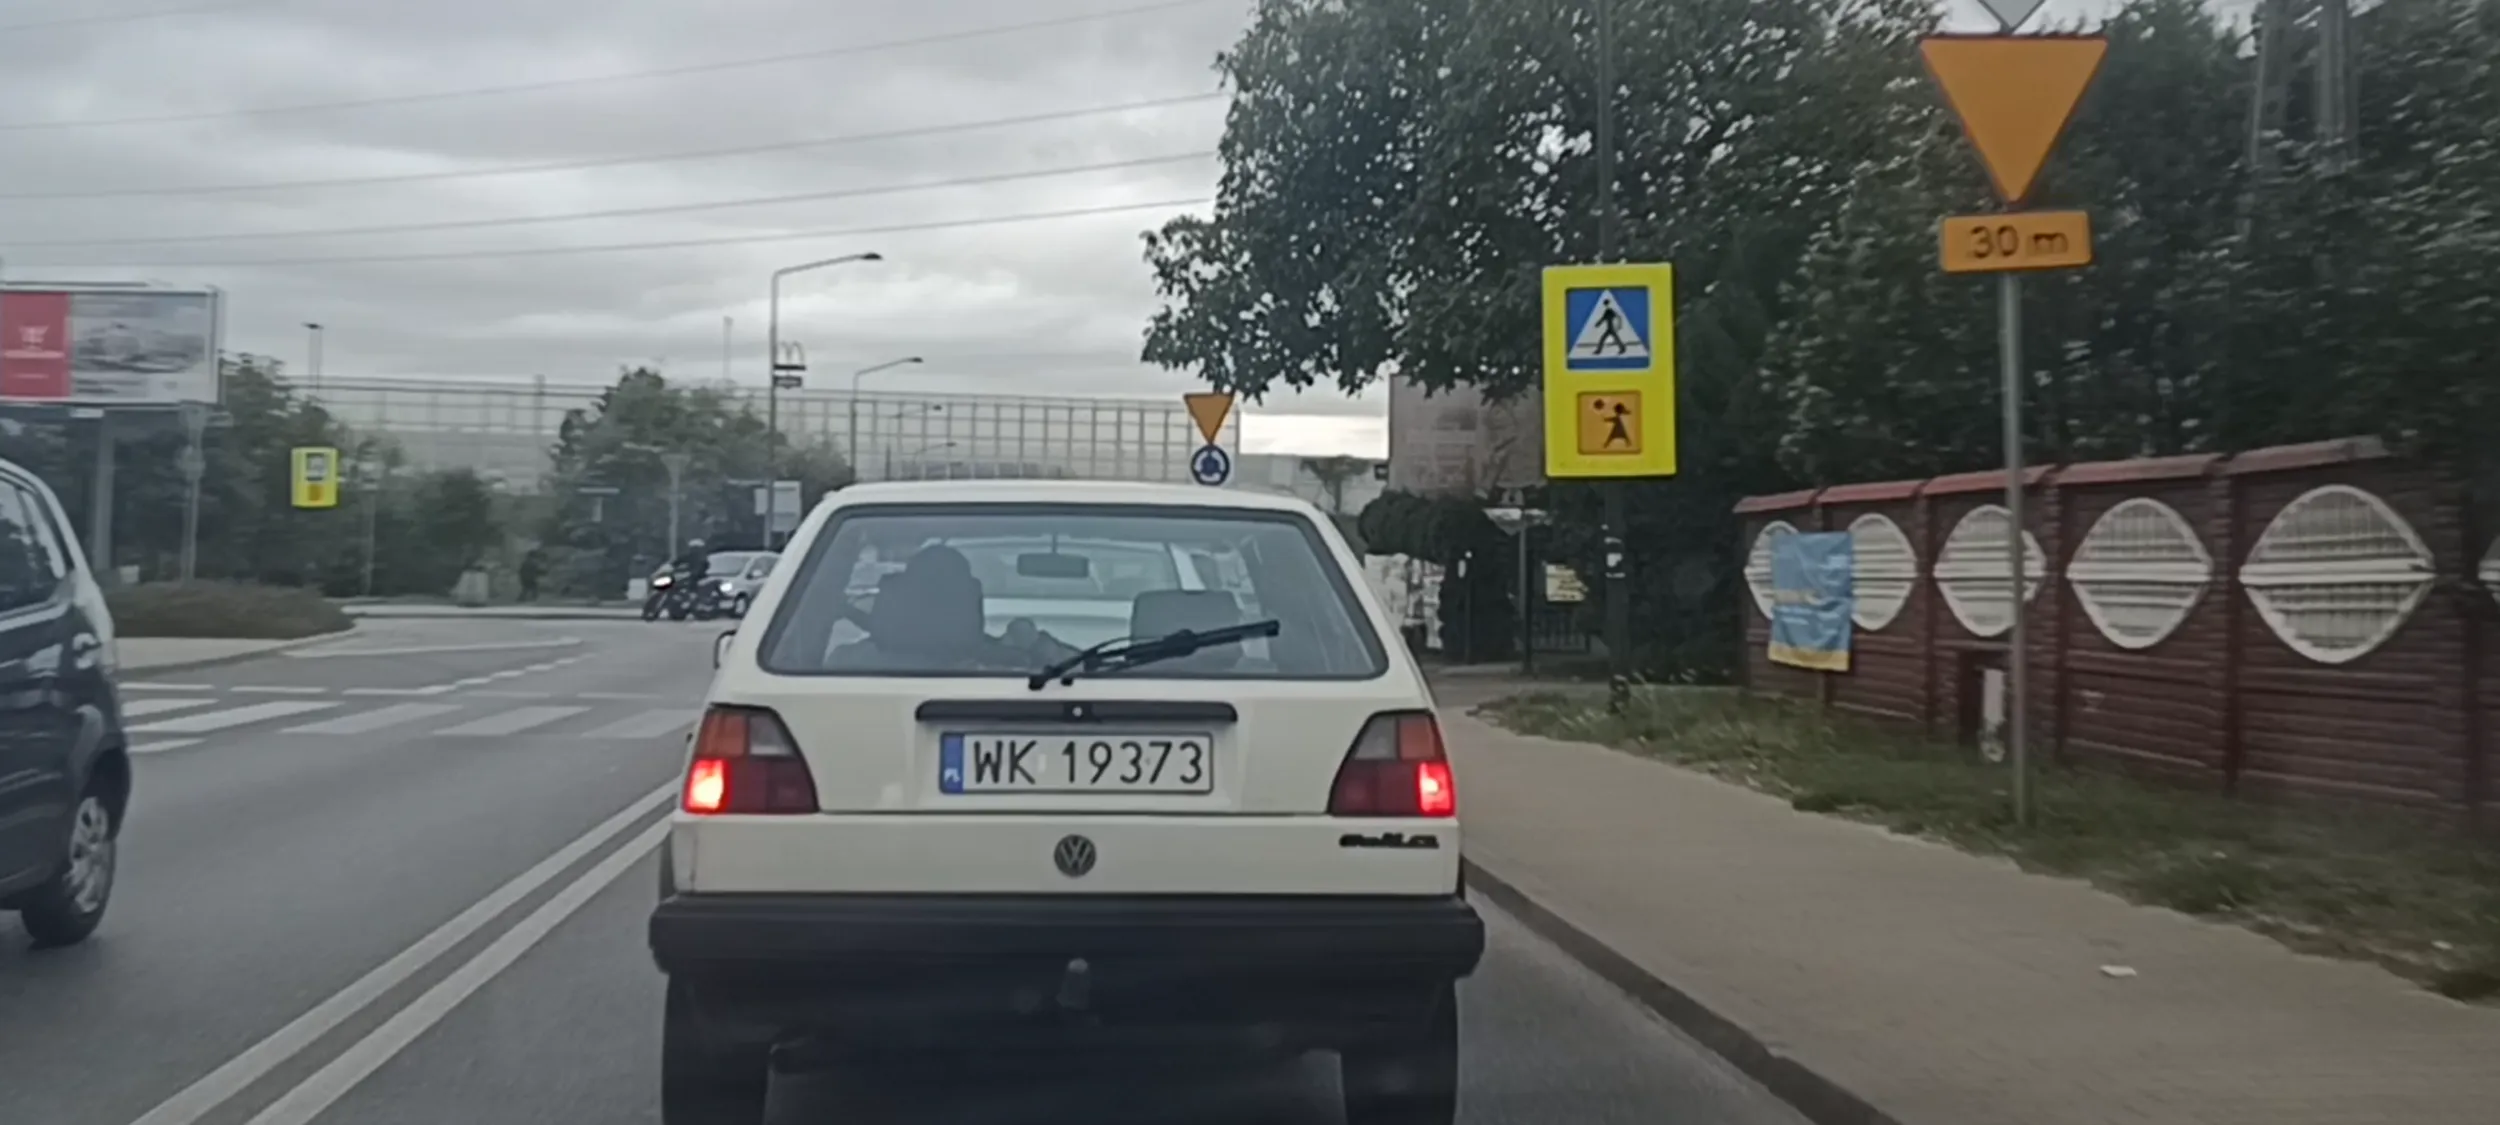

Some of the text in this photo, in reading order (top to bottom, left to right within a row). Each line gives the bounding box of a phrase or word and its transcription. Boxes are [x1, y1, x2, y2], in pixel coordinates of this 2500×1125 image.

[1969, 225, 2070, 259] 30 m
[974, 740, 1202, 784] WK 19373
